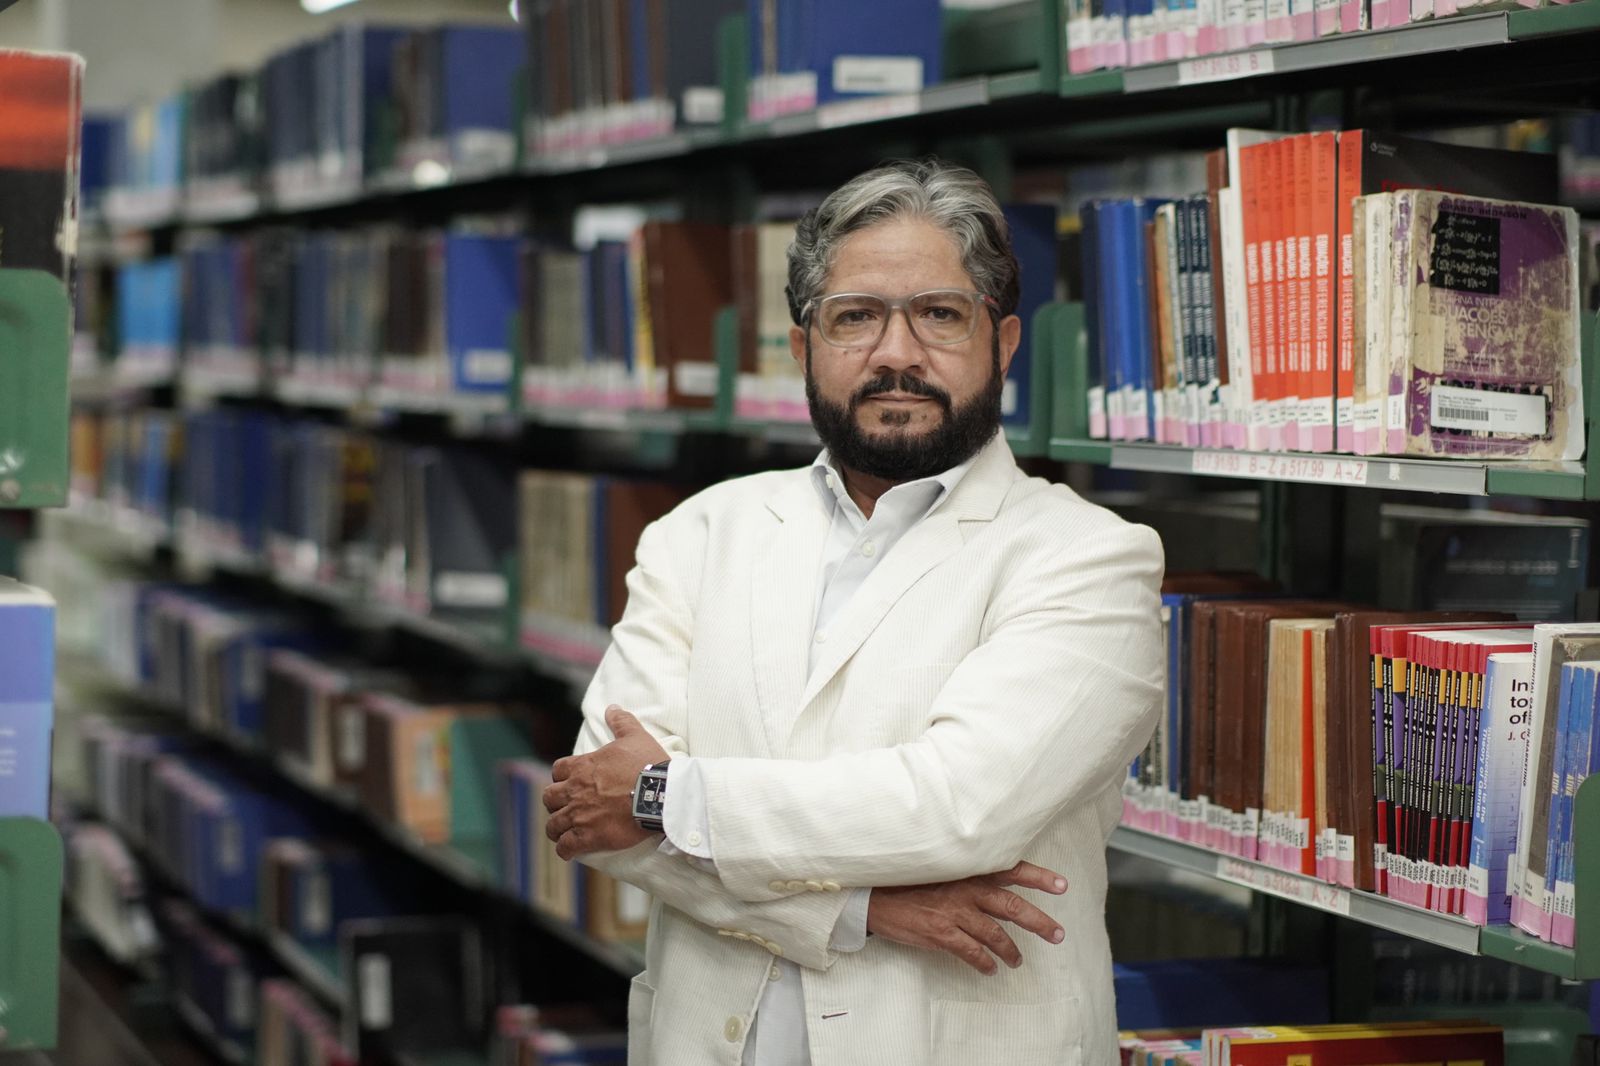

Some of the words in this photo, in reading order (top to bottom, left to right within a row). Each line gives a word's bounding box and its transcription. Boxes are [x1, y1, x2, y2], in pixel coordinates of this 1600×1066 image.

[1510, 696, 1528, 708] to
[1509, 711, 1528, 724] of
[1508, 732, 1516, 741] J.
[1480, 728, 1488, 764] Theory
[1484, 726, 1492, 790] Introduction
[1522, 738, 1530, 787] MARKETING
[1482, 792, 1488, 804] to
